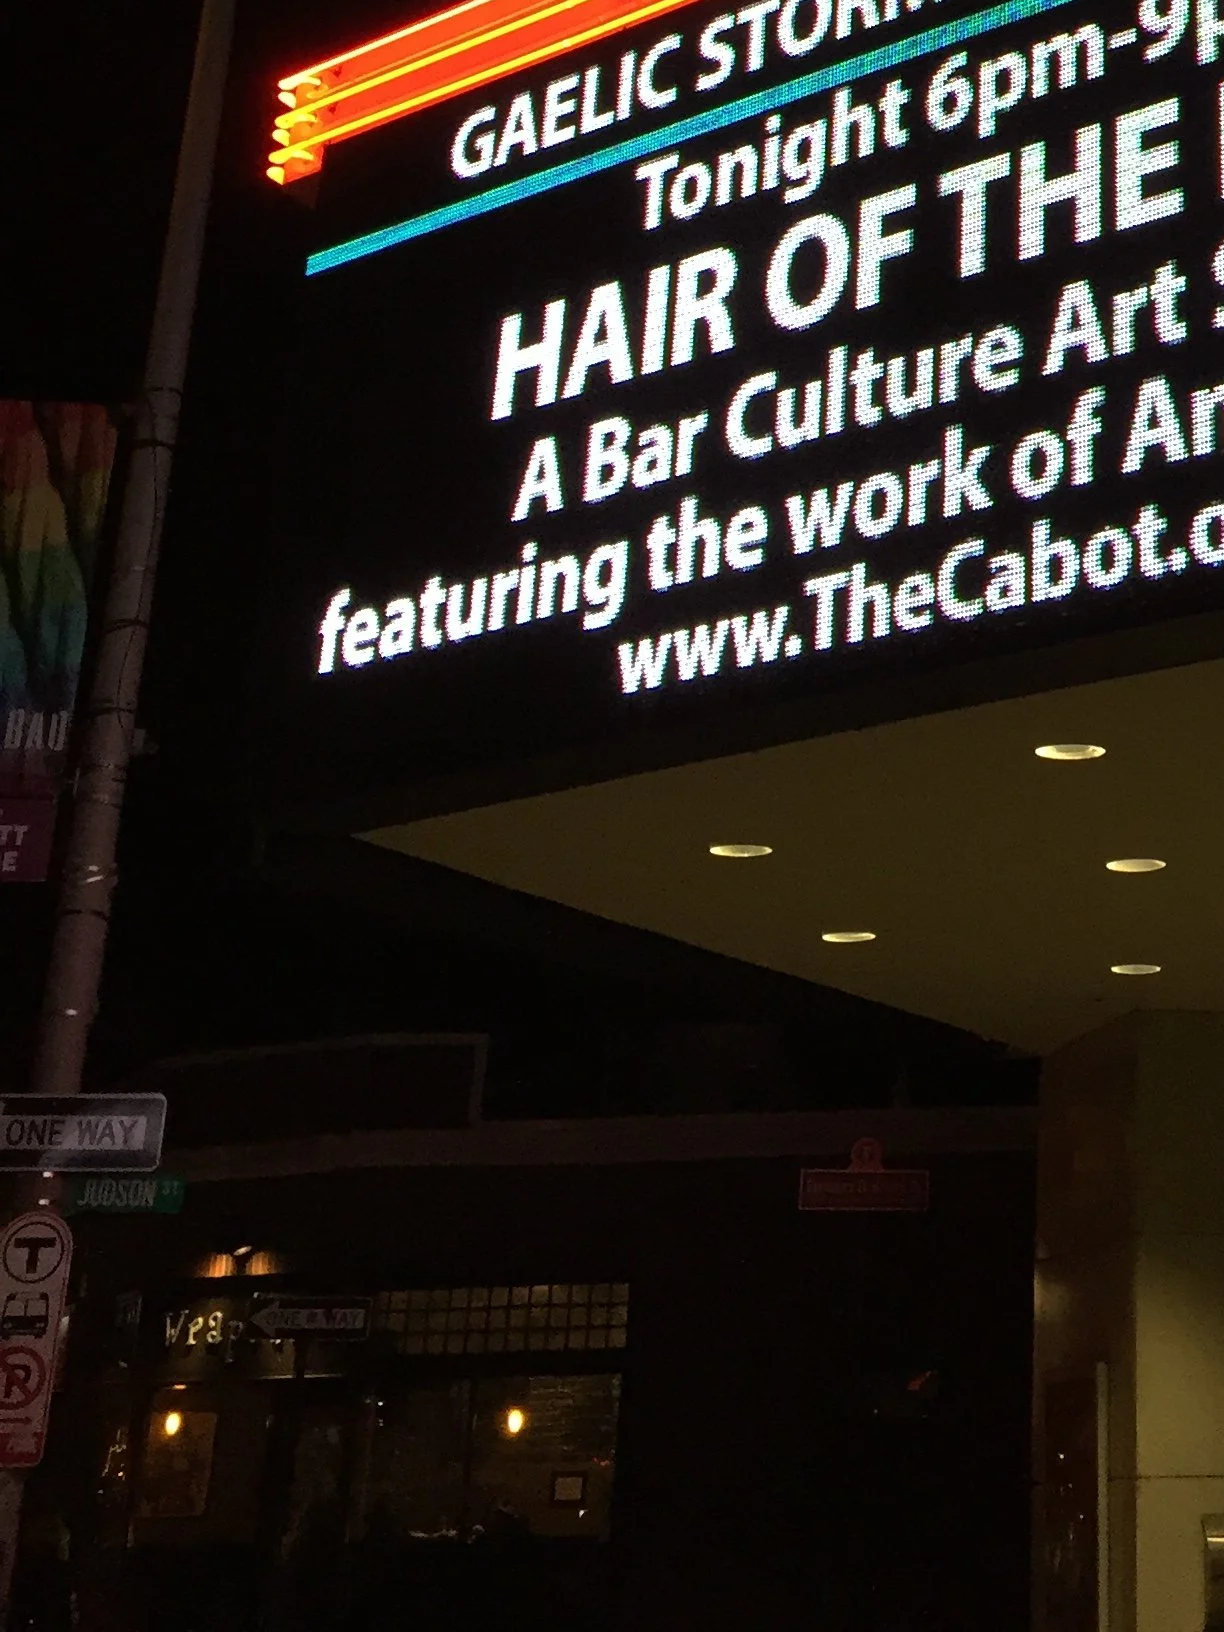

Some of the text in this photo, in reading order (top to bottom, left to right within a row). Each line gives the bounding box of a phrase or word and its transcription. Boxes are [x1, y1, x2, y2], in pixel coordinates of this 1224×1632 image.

[450, 34, 682, 179] GAELIC
[634, 79, 910, 230] Tonight
[490, 246, 740, 421] HAIR
[764, 183, 917, 332] OF
[936, 97, 1184, 279] THE
[511, 437, 564, 522] A
[583, 412, 710, 504] Bar
[724, 324, 1024, 460] Culture
[1042, 260, 1187, 376] Art
[317, 541, 629, 675] featuring
[646, 495, 770, 593] the
[785, 424, 994, 555] work
[1010, 387, 1106, 501] of
[6, 1118, 138, 1146] ONE WAY
[77, 1178, 156, 1207] JUDSON
